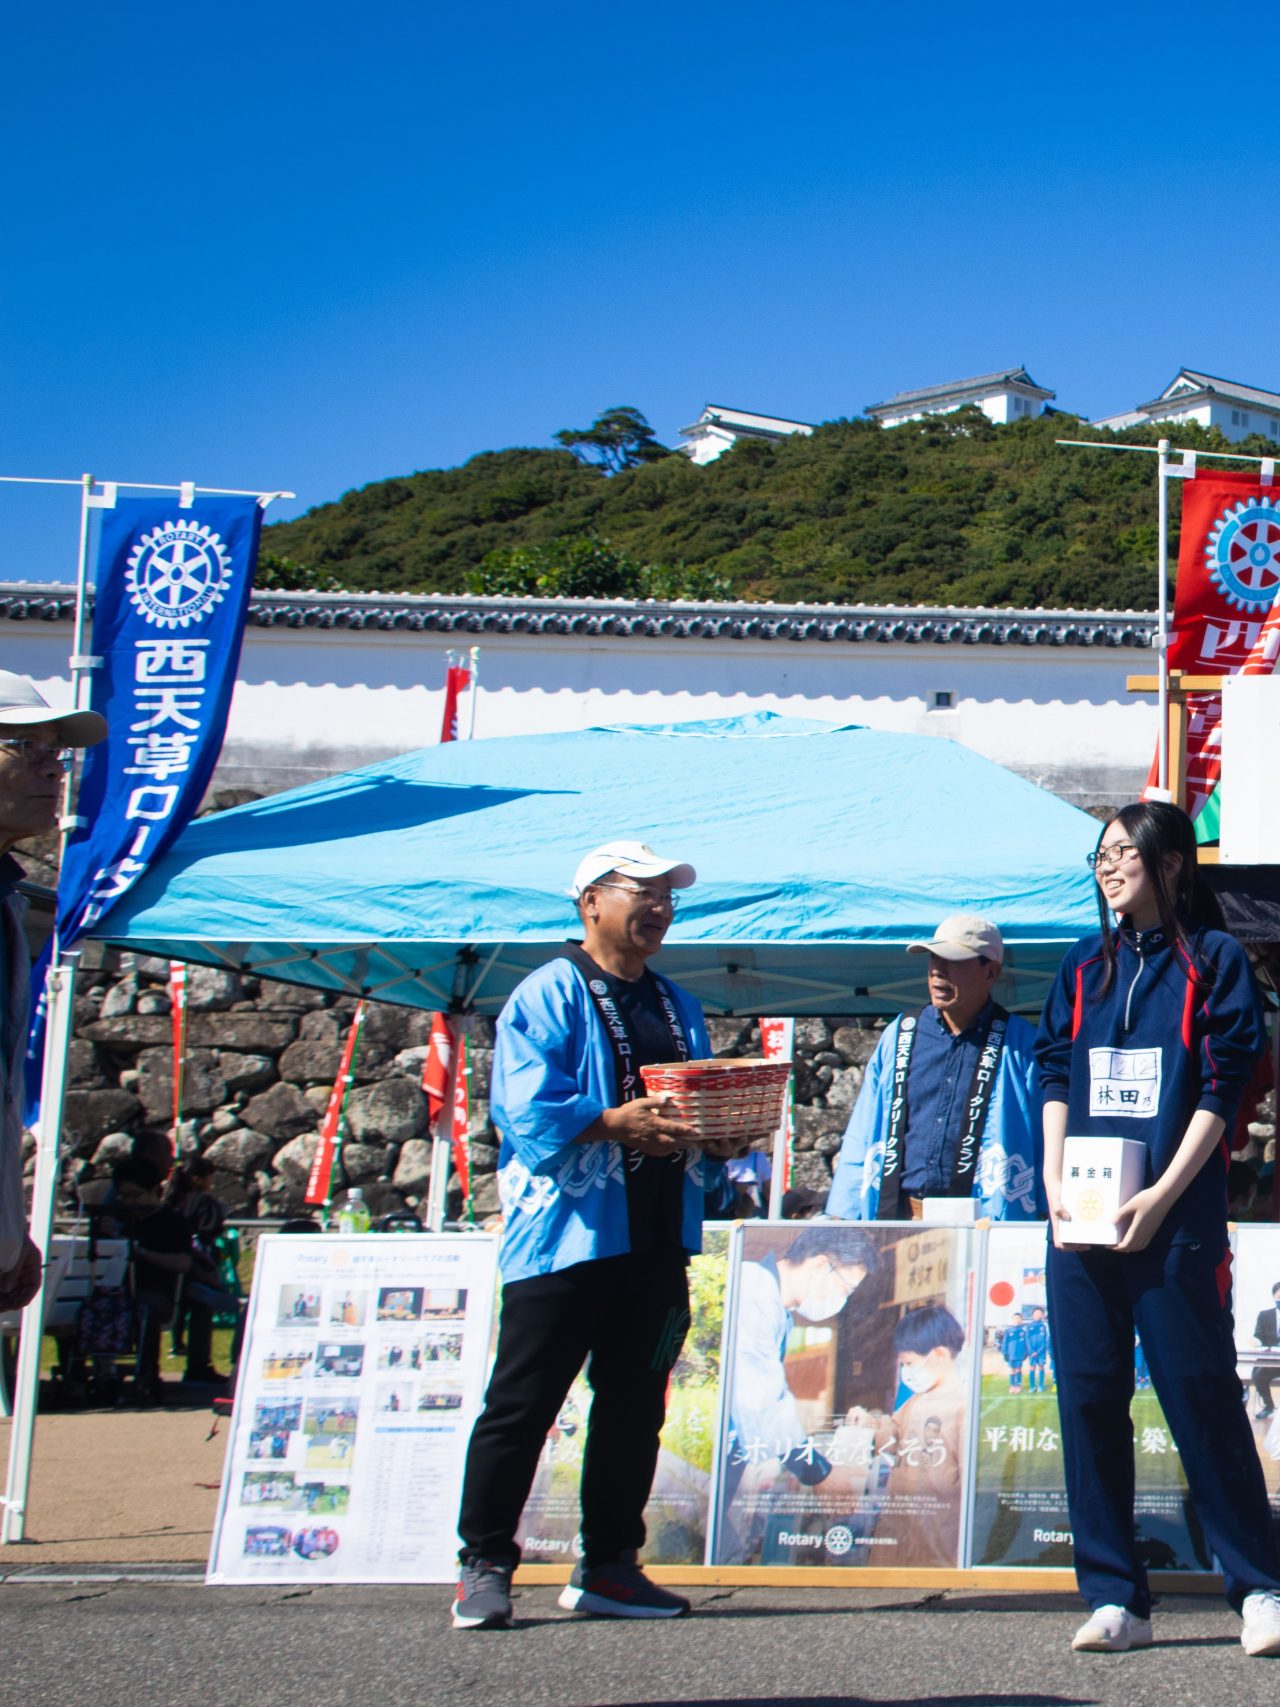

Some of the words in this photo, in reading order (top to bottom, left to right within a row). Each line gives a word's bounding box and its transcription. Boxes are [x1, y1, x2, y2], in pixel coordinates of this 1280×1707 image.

[158, 531, 203, 545] ROTARY
[140, 585, 216, 618] INTERNATIONAL
[884, 1032, 914, 1177] 西天草ロータリークラブ
[957, 1032, 1003, 1174] 西天草ロータリークラブ
[1070, 1166, 1113, 1179] 募金箱
[525, 1537, 569, 1552] Rotary
[778, 1531, 822, 1549] Rotary
[1033, 1528, 1074, 1545] Rotary
